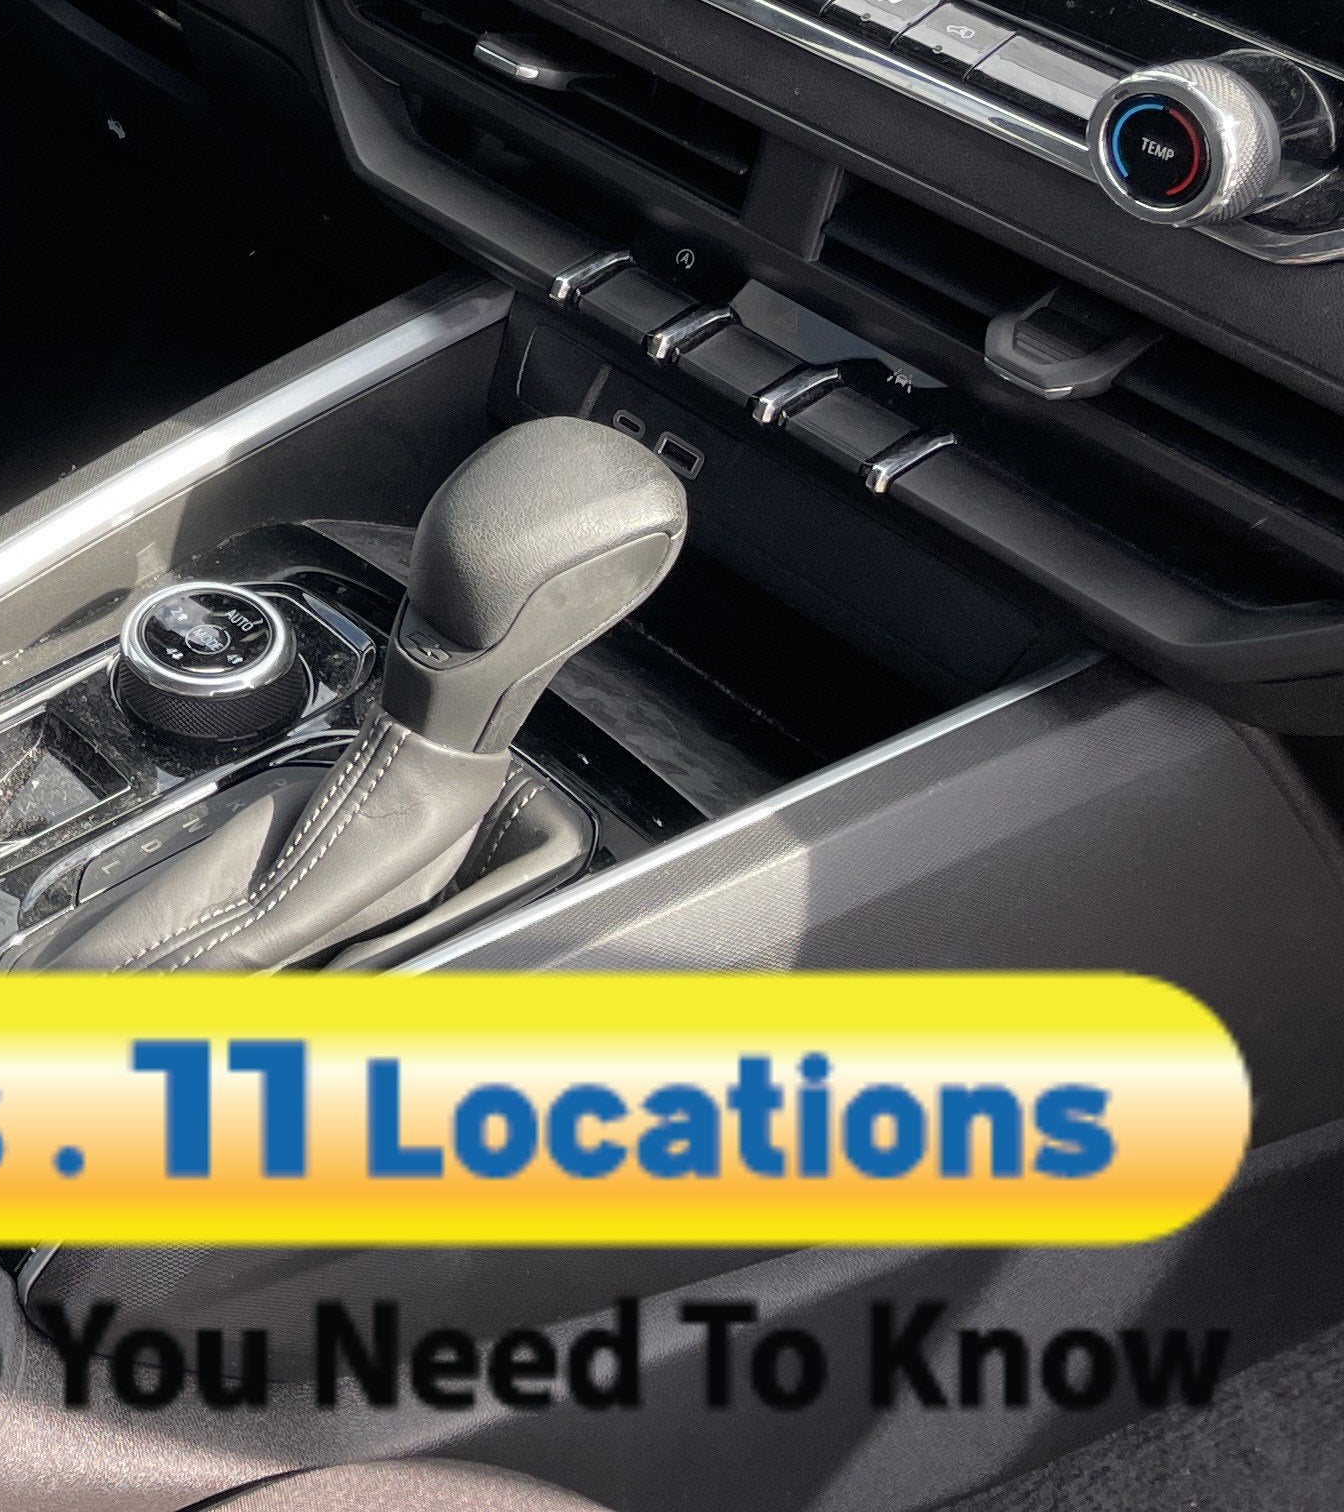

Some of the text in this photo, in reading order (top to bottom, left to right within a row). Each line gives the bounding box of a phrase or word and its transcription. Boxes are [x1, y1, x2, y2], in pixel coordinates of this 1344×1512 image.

[1141, 136, 1176, 162] TEMP
[226, 608, 255, 632] AUTO
[191, 627, 225, 652] MODE
